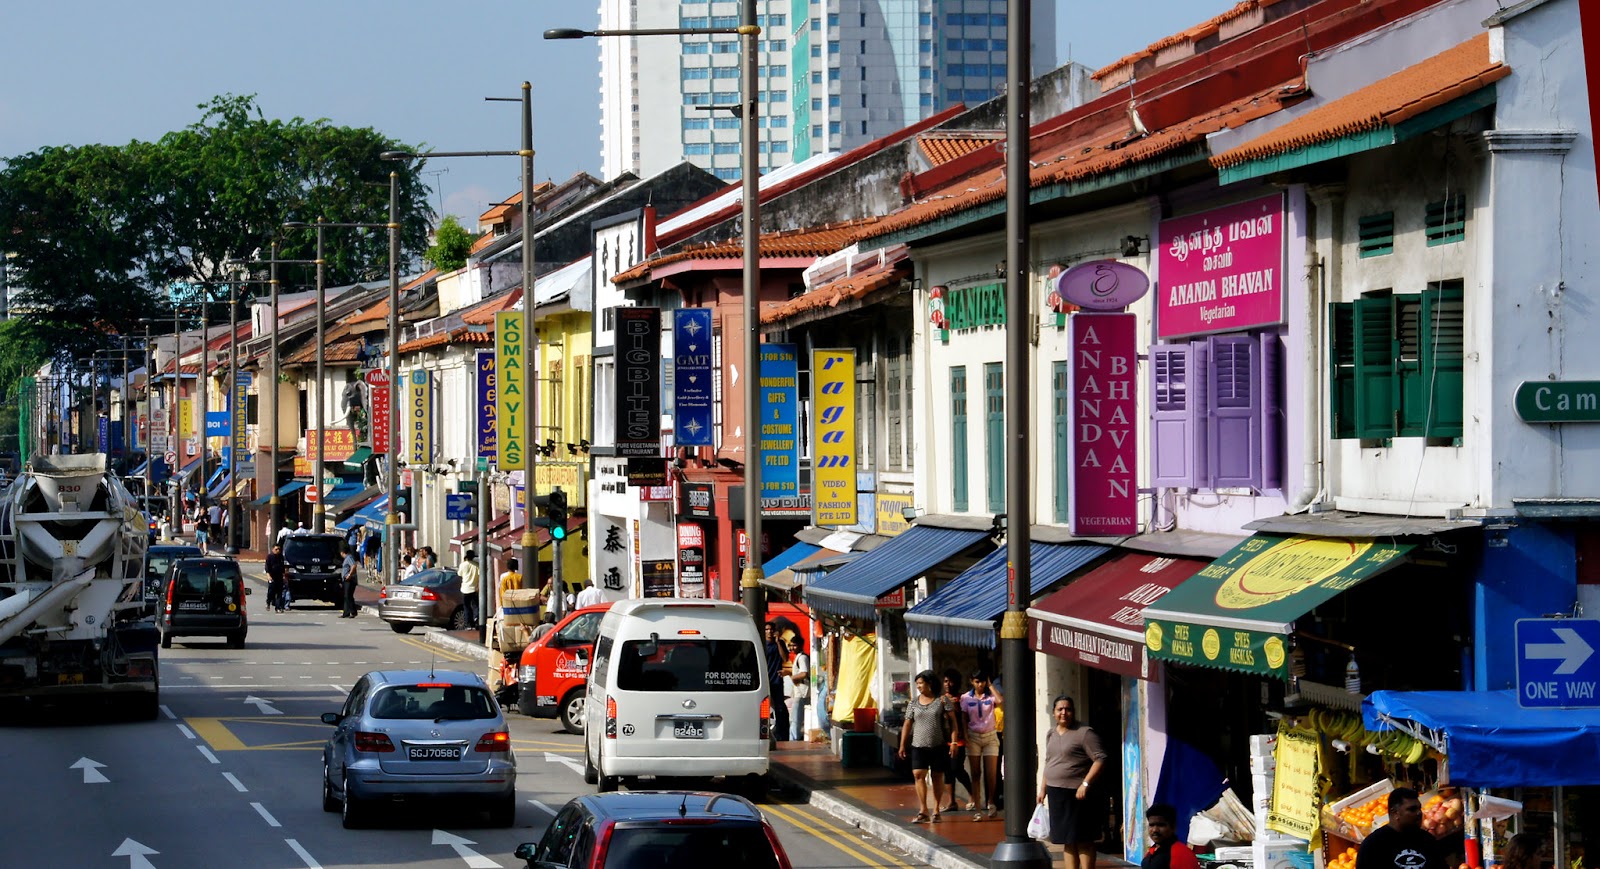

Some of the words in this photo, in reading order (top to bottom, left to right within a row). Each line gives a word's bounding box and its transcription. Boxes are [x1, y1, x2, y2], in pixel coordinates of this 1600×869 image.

[1229, 205, 1273, 242] பவன்
[1169, 279, 1217, 307] ANANDA
[1221, 268, 1274, 298] BHAVAN
[1200, 303, 1236, 324] Vegetarian
[504, 318, 520, 395] KOMALA
[676, 355, 710, 365] GMT
[765, 353, 778, 361] FOR
[767, 393, 786, 403] GIFTS
[1080, 325, 1102, 468] ANANDA
[414, 388, 424, 418] UCO
[374, 389, 382, 438] COSTUME
[774, 408, 780, 420] &
[381, 397, 390, 452] JEWELLERY
[762, 424, 793, 435] COSTUME
[1107, 356, 1130, 498] BHAVAN
[504, 402, 521, 465] VILAS
[414, 421, 425, 462] BANK
[765, 456, 777, 466] PTE
[778, 457, 790, 466] LTD
[766, 482, 780, 490] FOR
[822, 480, 847, 488] VIDEO
[818, 501, 852, 509] FASHION
[819, 512, 834, 520] PTE
[836, 512, 851, 520] LTD
[1080, 516, 1131, 526] VEGETARIAN
[680, 526, 701, 536] DINING
[680, 537, 702, 546] UPSTAIRS
[1050, 626, 1074, 648] ANANDA
[1074, 631, 1098, 654] BHAVAN
[1098, 637, 1133, 662] VEGETARIAN
[1525, 681, 1558, 699] ONE
[1566, 682, 1596, 699] WAY
[674, 728, 703, 737] 8249C
[410, 748, 460, 758] SGJ7058C
